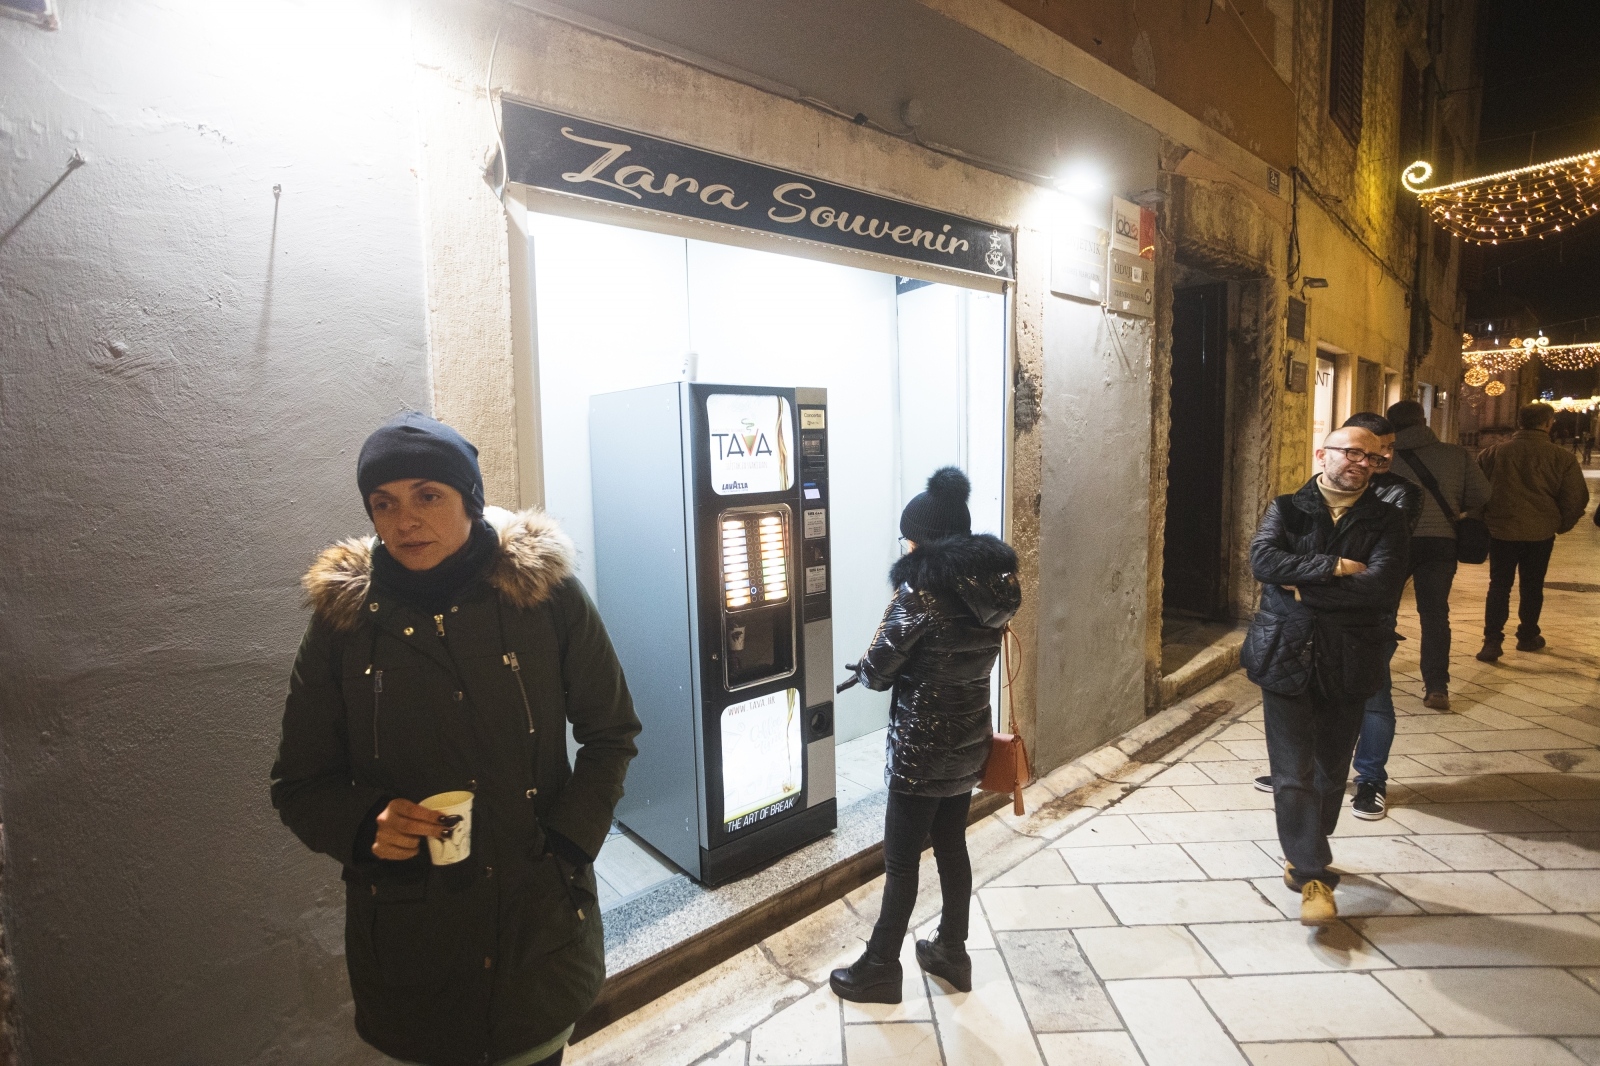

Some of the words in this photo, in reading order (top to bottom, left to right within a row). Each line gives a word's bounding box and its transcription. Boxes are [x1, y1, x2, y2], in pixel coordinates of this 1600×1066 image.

[560, 126, 749, 211] Zara
[767, 182, 969, 256] Souvenir
[1114, 263, 1150, 282] ODVJIK
[711, 429, 772, 461] TAVA
[721, 481, 749, 491] LAVAZZA
[727, 818, 742, 833] THE
[743, 811, 758, 827] ART
[759, 808, 769, 820] OF
[770, 797, 795, 816] BREAK
